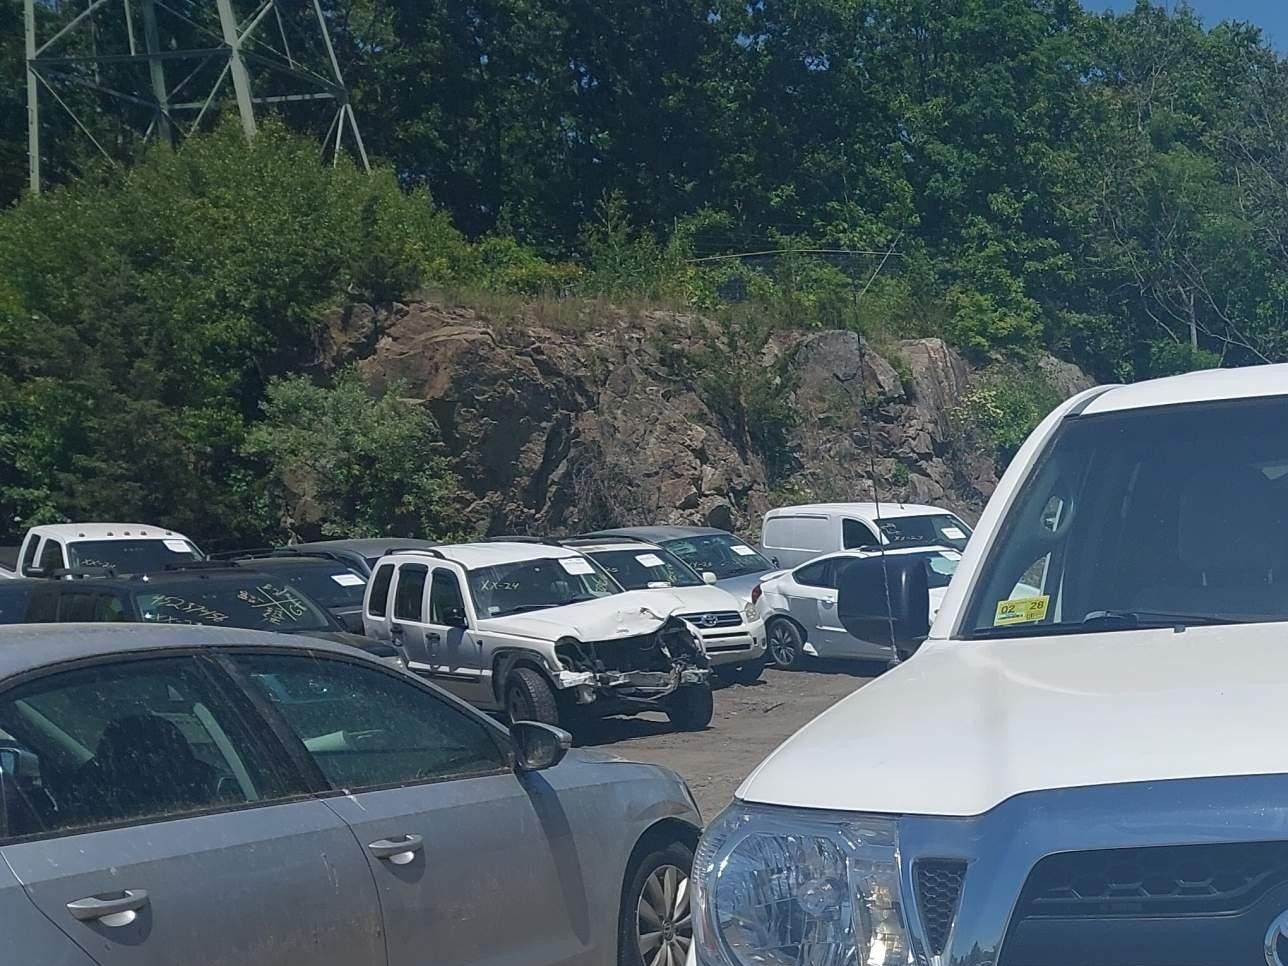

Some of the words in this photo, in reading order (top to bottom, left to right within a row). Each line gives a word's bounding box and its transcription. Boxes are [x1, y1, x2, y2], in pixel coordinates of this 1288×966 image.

[480, 579, 520, 591] XX-24
[1001, 604, 1016, 614] 02
[1029, 600, 1045, 610] 28
